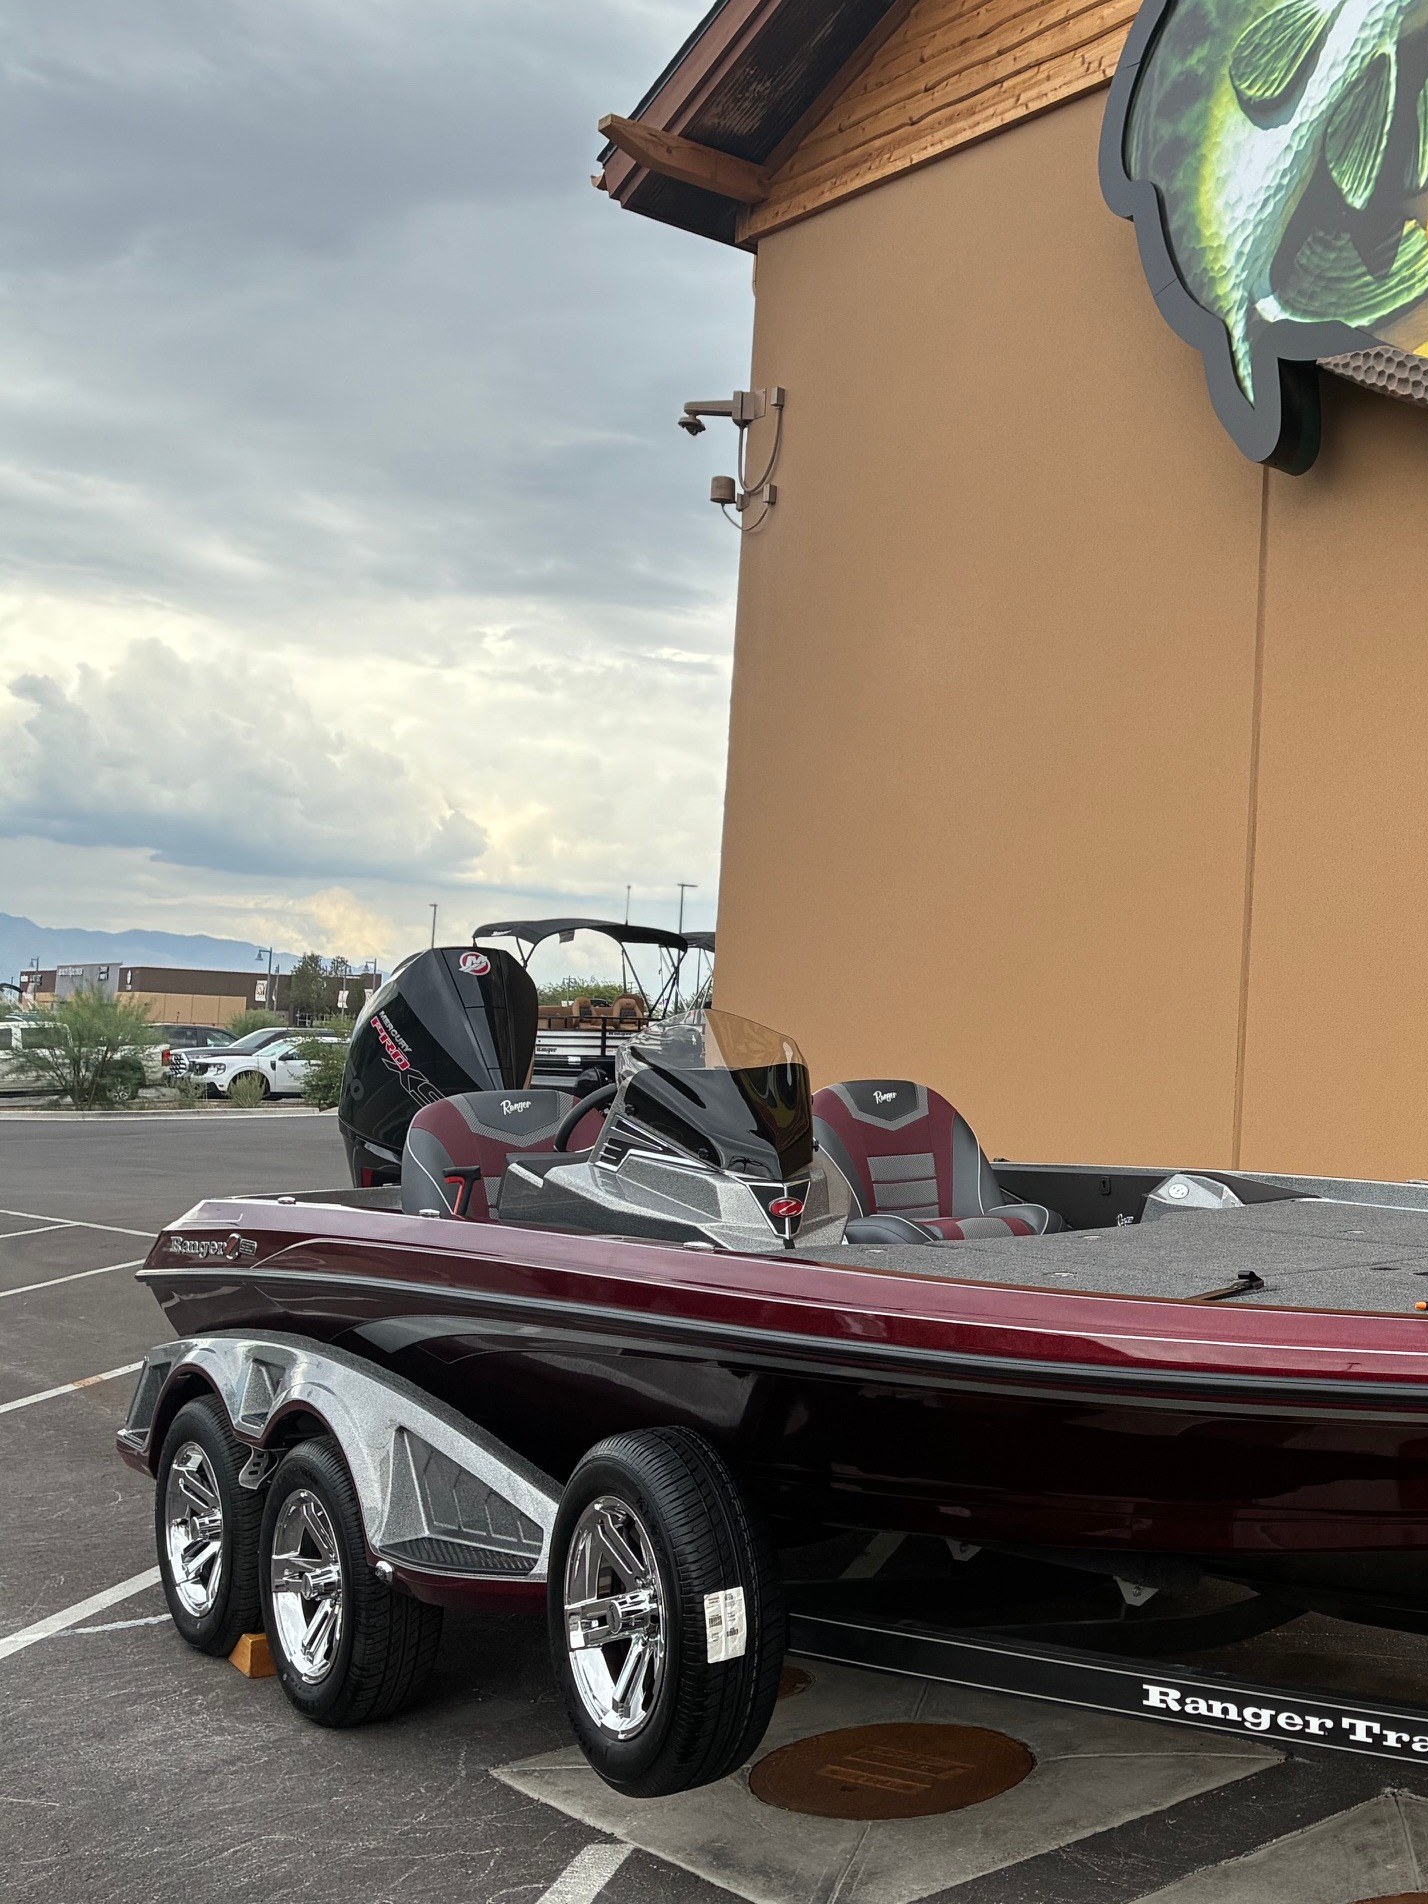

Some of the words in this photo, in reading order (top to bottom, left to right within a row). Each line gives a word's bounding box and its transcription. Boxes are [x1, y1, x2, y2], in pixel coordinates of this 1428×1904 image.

[370, 1015, 411, 1071] PRO
[379, 1010, 413, 1052] MERCURY
[500, 1099, 532, 1116] Ranger
[169, 1236, 227, 1259] Ranger
[1142, 1684, 1334, 1735] Ranger
